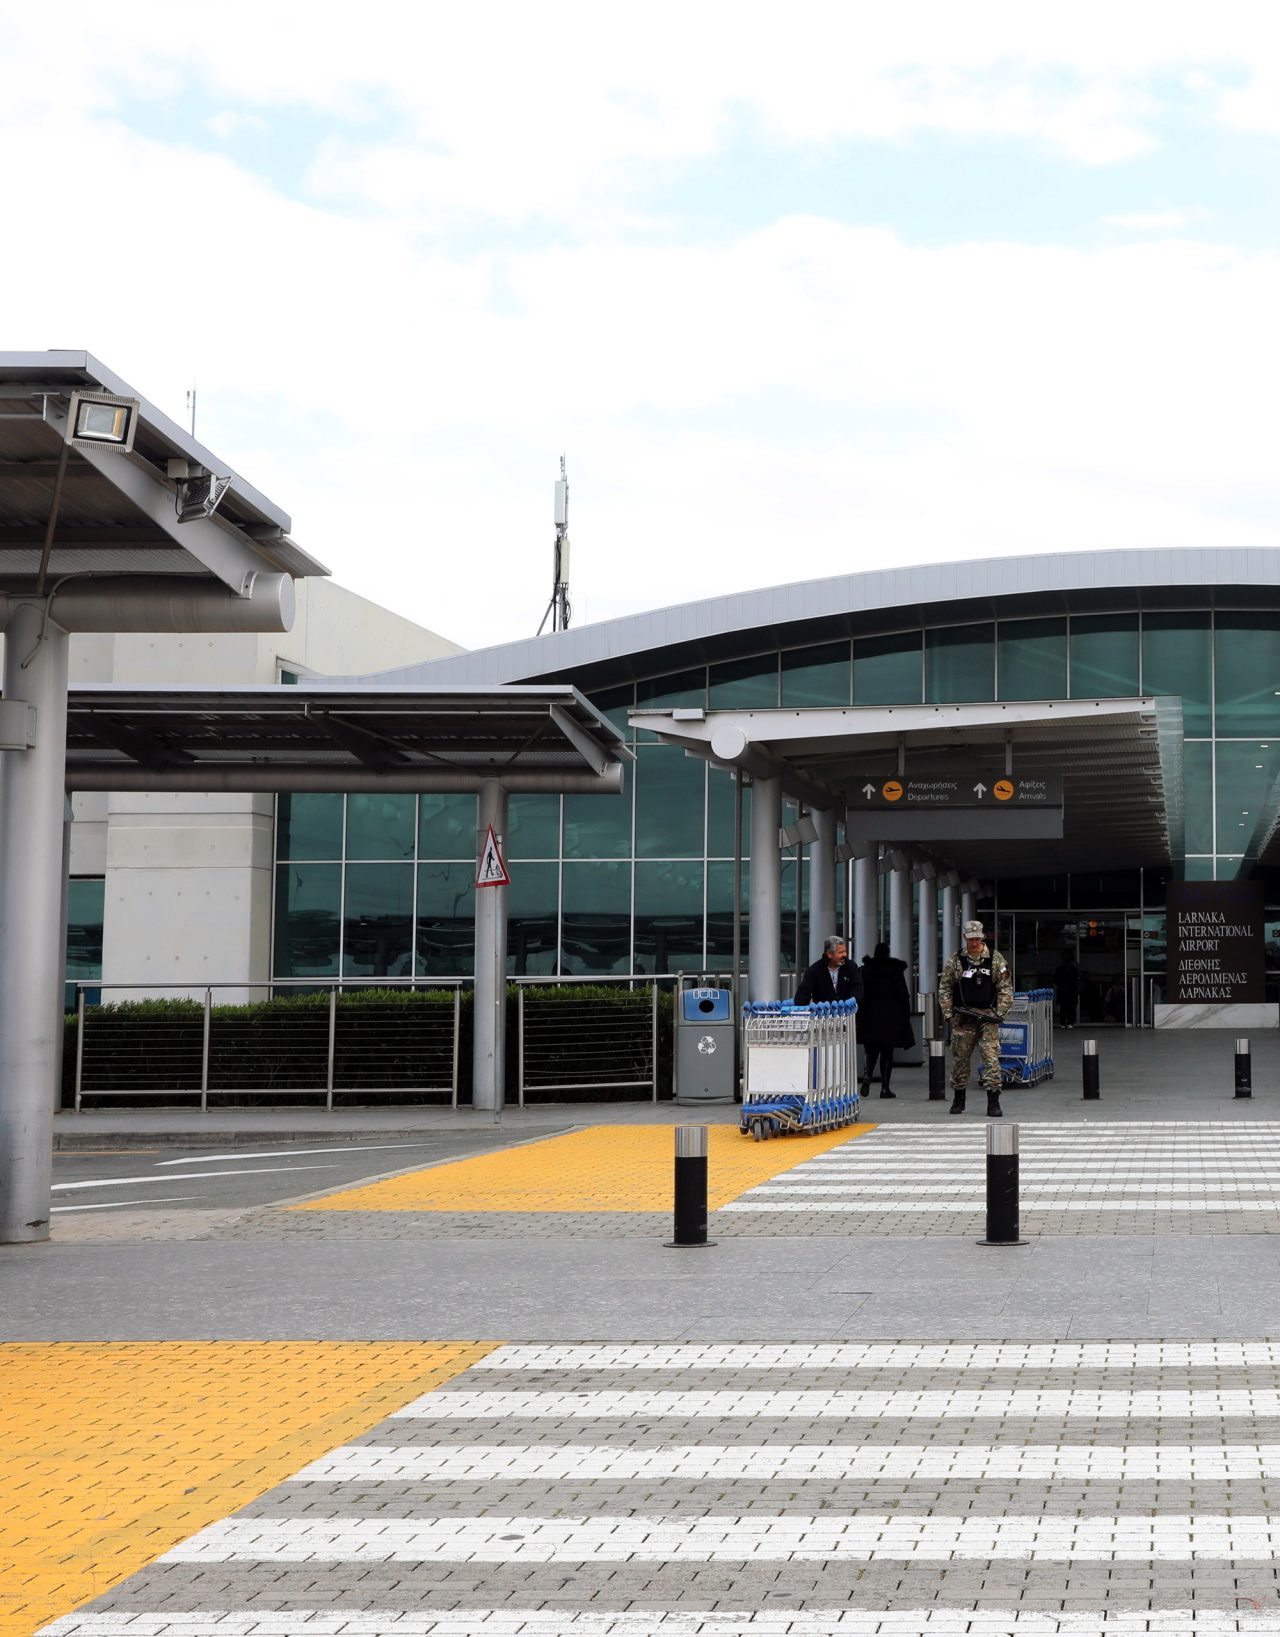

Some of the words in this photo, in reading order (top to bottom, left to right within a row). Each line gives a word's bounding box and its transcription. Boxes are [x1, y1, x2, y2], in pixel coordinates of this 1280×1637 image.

[908, 781, 958, 790] Αναχωρήσεις
[1019, 780, 1046, 790] Αφίξεις
[907, 793, 949, 802] Departures
[1019, 792, 1047, 800] Arrivals
[1178, 912, 1226, 924] LARNAKA
[1178, 925, 1254, 938] INTERNATIONAL
[1178, 939, 1220, 951] AIRPORT
[1178, 959, 1221, 971] ΔΙΕΘΝΗΣ
[1178, 972, 1248, 985] ΑΕΡΟΛΙΜΕΝΑΣ
[1179, 986, 1232, 999] ΛΑΡΝΑΚΑΣ
